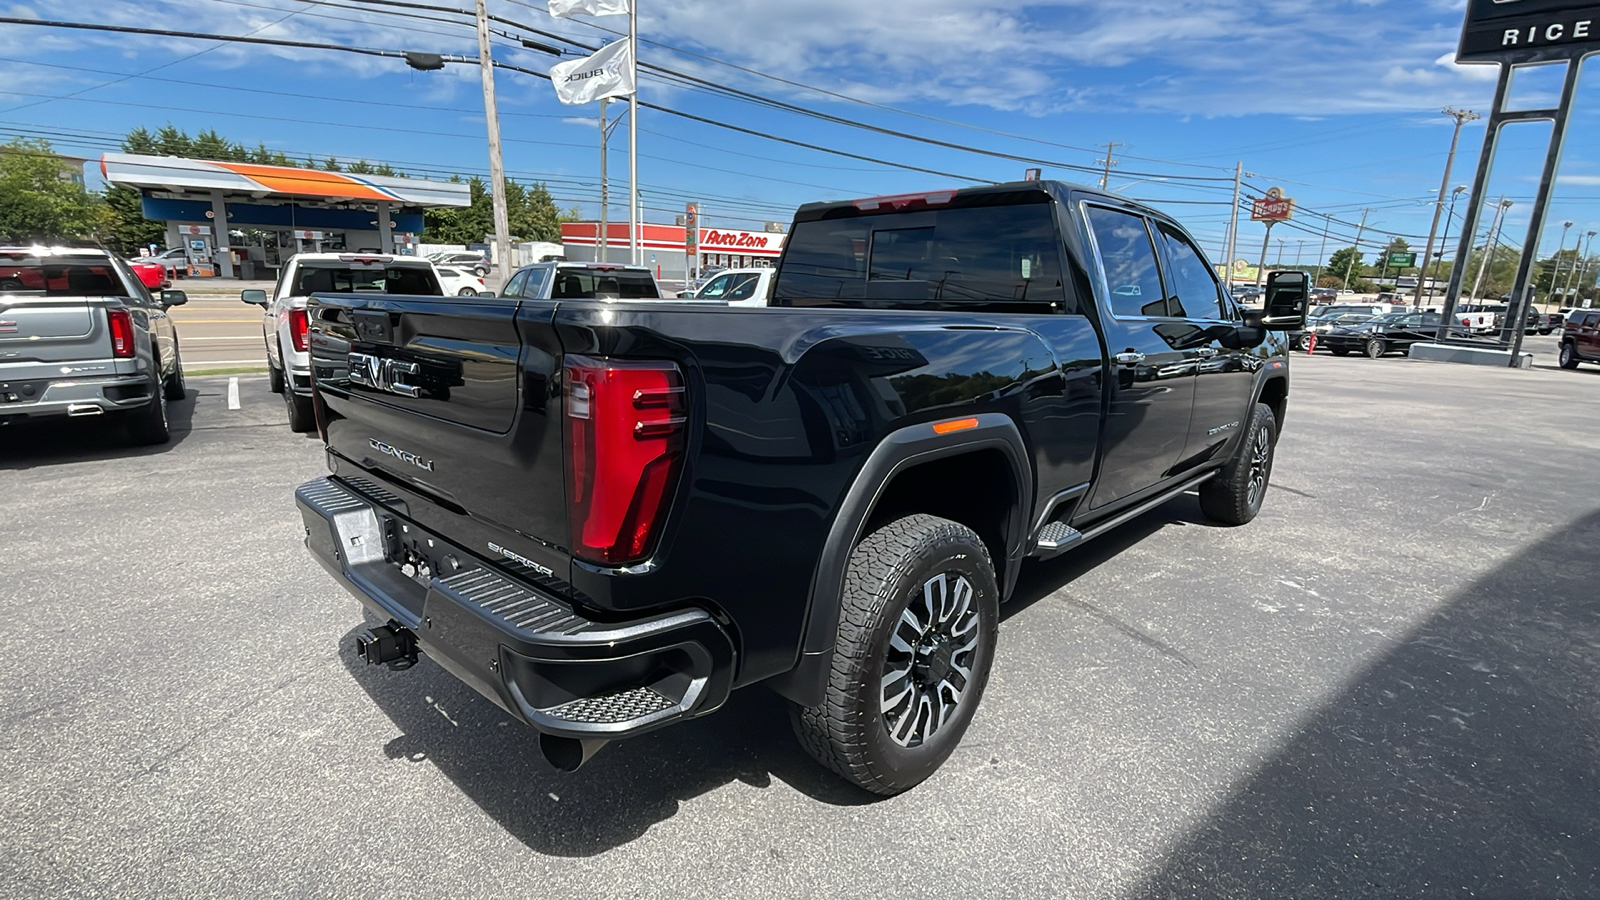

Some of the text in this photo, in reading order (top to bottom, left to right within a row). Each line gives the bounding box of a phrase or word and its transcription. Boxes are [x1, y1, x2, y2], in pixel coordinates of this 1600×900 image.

[1502, 21, 1591, 45] RICE
[347, 352, 422, 398] GMC
[369, 437, 434, 472] DENALI
[487, 541, 554, 578] SIERRA
